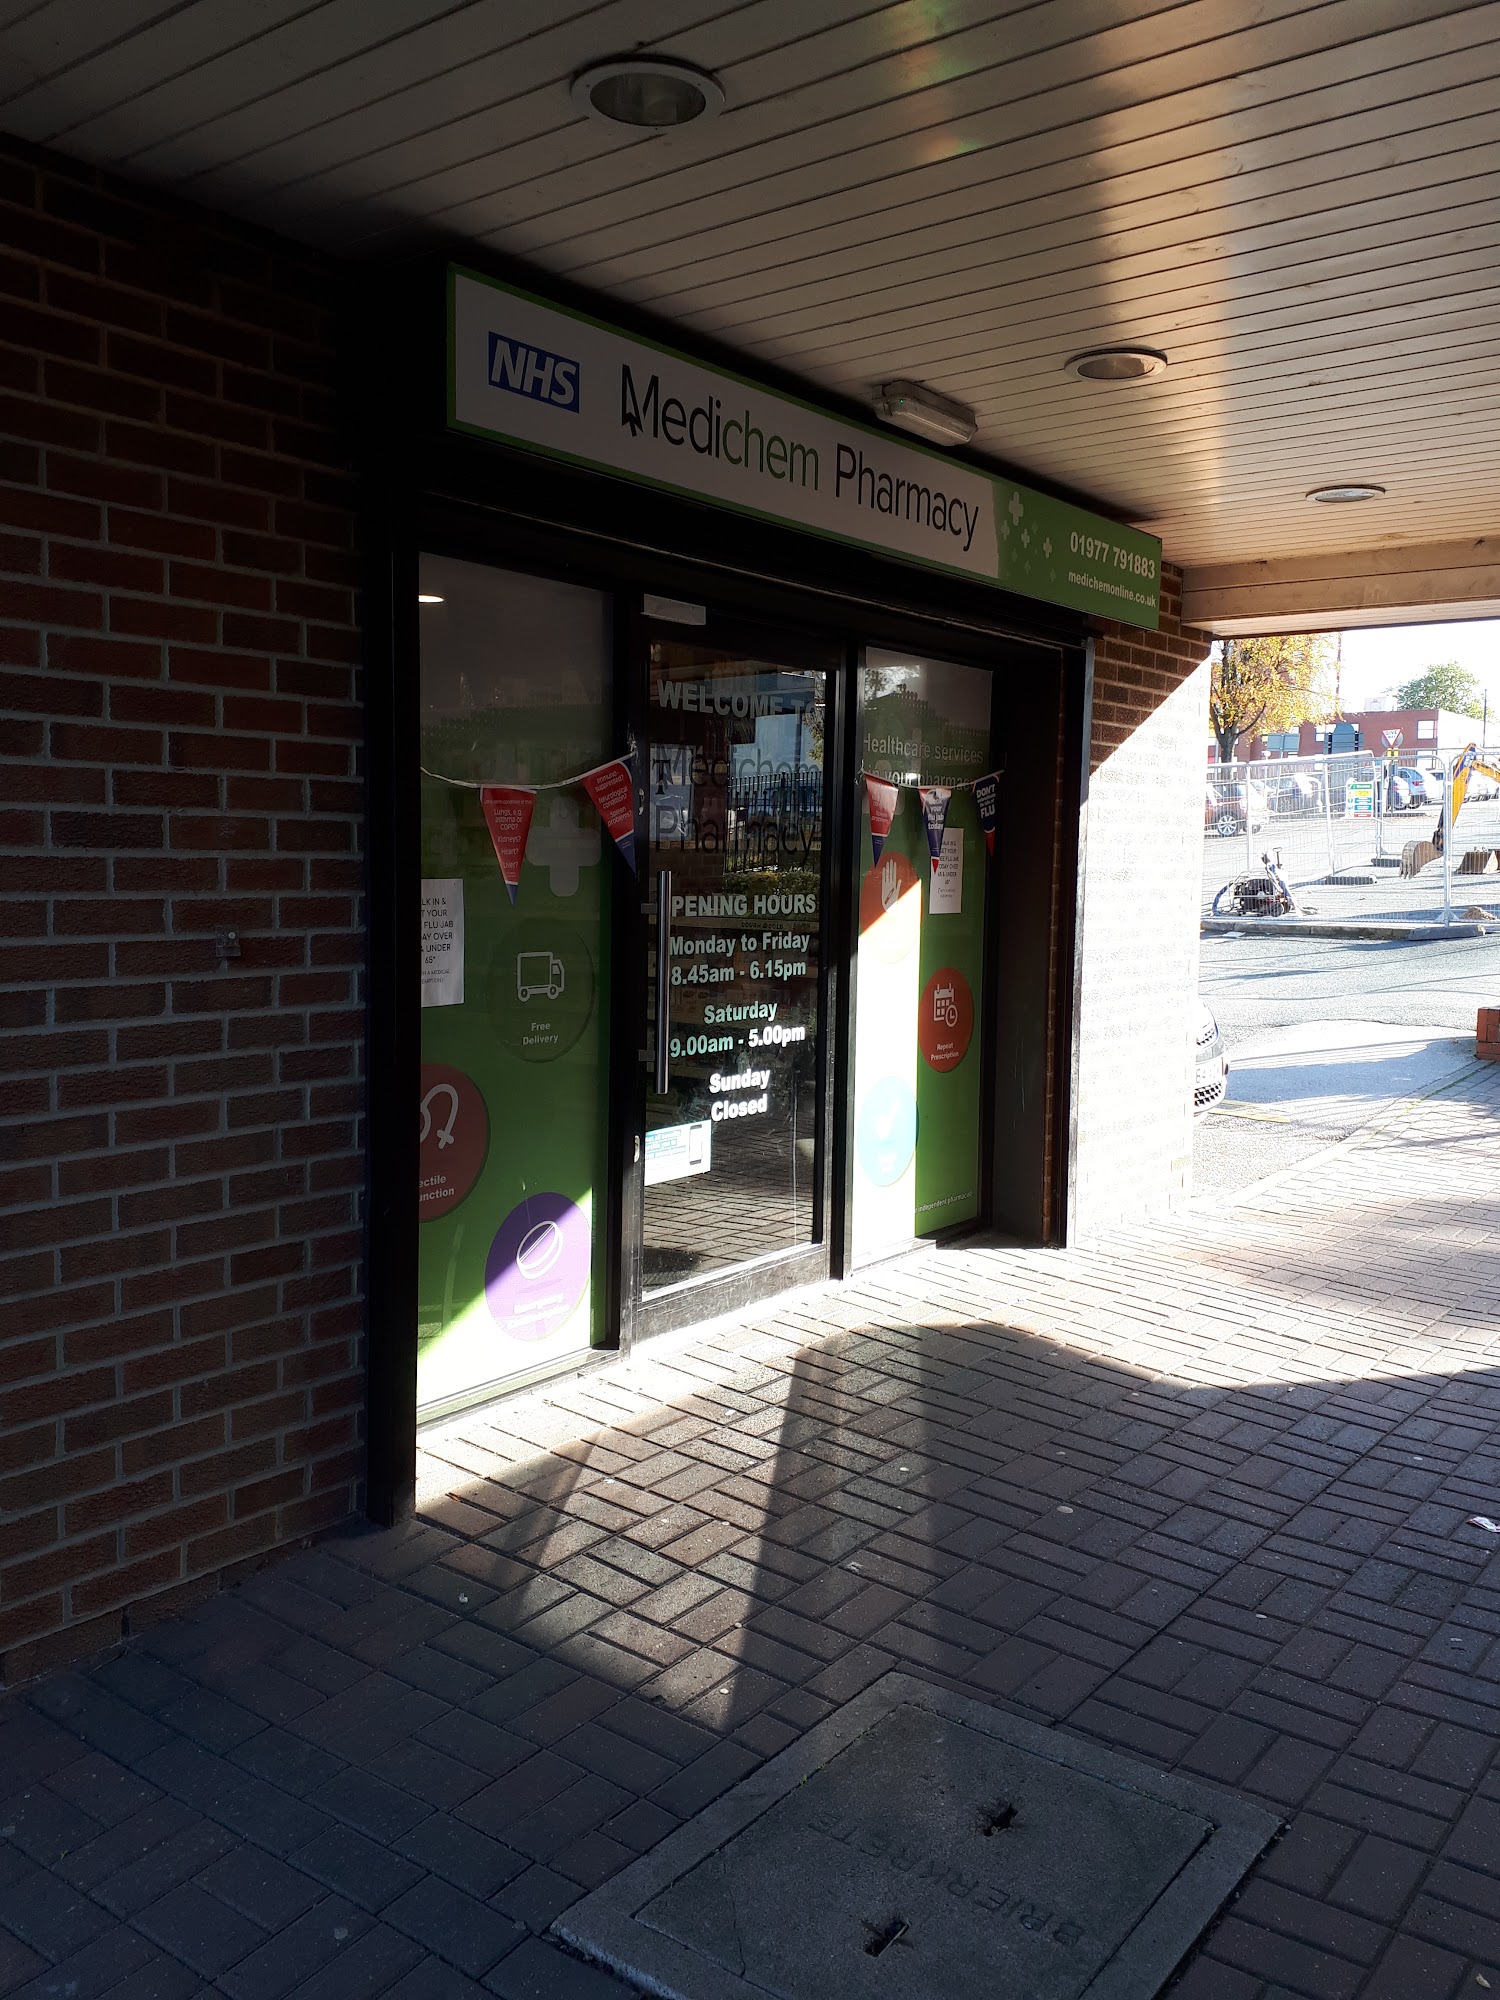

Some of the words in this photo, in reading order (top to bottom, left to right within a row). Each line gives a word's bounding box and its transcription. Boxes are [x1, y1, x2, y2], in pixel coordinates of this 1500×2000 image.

[491, 339, 577, 405] NHS
[622, 364, 819, 490] Medichem
[835, 443, 979, 551] Pharmacy
[1070, 531, 1110, 563] 01977
[1113, 546, 1156, 579] 791883
[1068, 571, 1157, 608] medichemonline.co.uk
[657, 679, 783, 718] WELCOME
[864, 733, 931, 759] Healthcare
[935, 744, 984, 764] services
[918, 770, 975, 791] pharmac
[980, 803, 996, 819] FLU
[503, 861, 519, 869] Liver?
[433, 897, 440, 906] IN
[671, 895, 748, 917] PENING
[753, 894, 816, 916] HOURS
[427, 909, 448, 917] YOUR
[424, 921, 439, 929] FLU
[440, 920, 454, 929] JAB
[433, 931, 453, 940] OVER
[426, 943, 451, 952] UNDER
[670, 934, 736, 958] Monday
[741, 934, 757, 952] to
[762, 931, 810, 953] Friday
[671, 962, 735, 986] 8.45am
[749, 959, 807, 981] 6.15pm
[704, 1001, 778, 1025] Saturday
[531, 1022, 551, 1031] Free
[522, 1034, 559, 1046] Delivery
[669, 1034, 734, 1058] 9.00am
[748, 1024, 806, 1048] 5.00pm
[936, 1042, 954, 1051] Repeat
[930, 1051, 960, 1061] Prescription
[708, 1068, 771, 1095] Sunday
[711, 1094, 768, 1122] Closed
[419, 1174, 447, 1188] ectile
